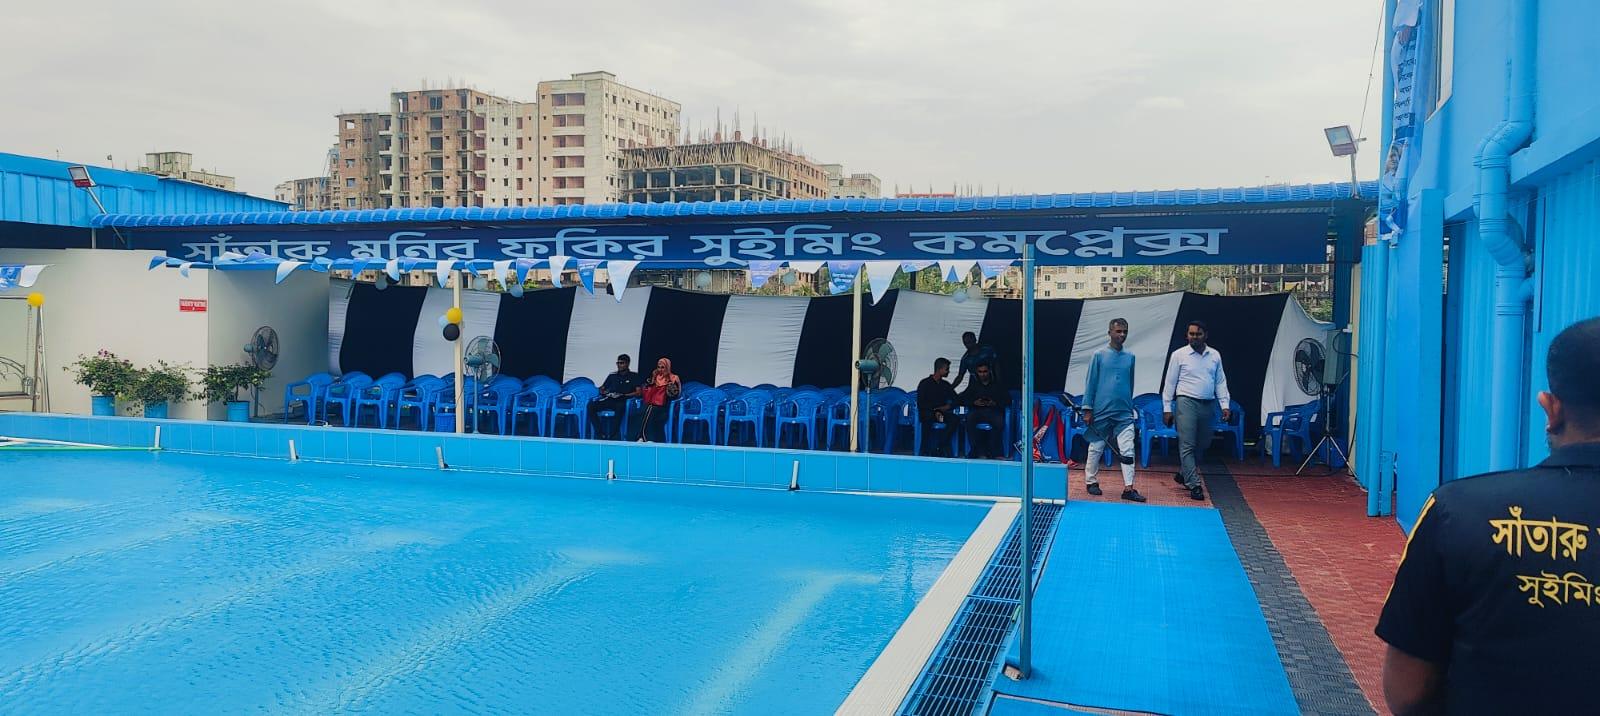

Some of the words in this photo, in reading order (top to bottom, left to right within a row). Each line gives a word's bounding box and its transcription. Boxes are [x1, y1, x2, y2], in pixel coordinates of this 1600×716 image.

[182, 233, 331, 262] সাঁতারু
[498, 228, 669, 260] ফকির
[690, 225, 886, 266] সুইমিং
[909, 226, 1229, 258] কমপ্লেক্স
[1488, 506, 1590, 562] সাঁতারু
